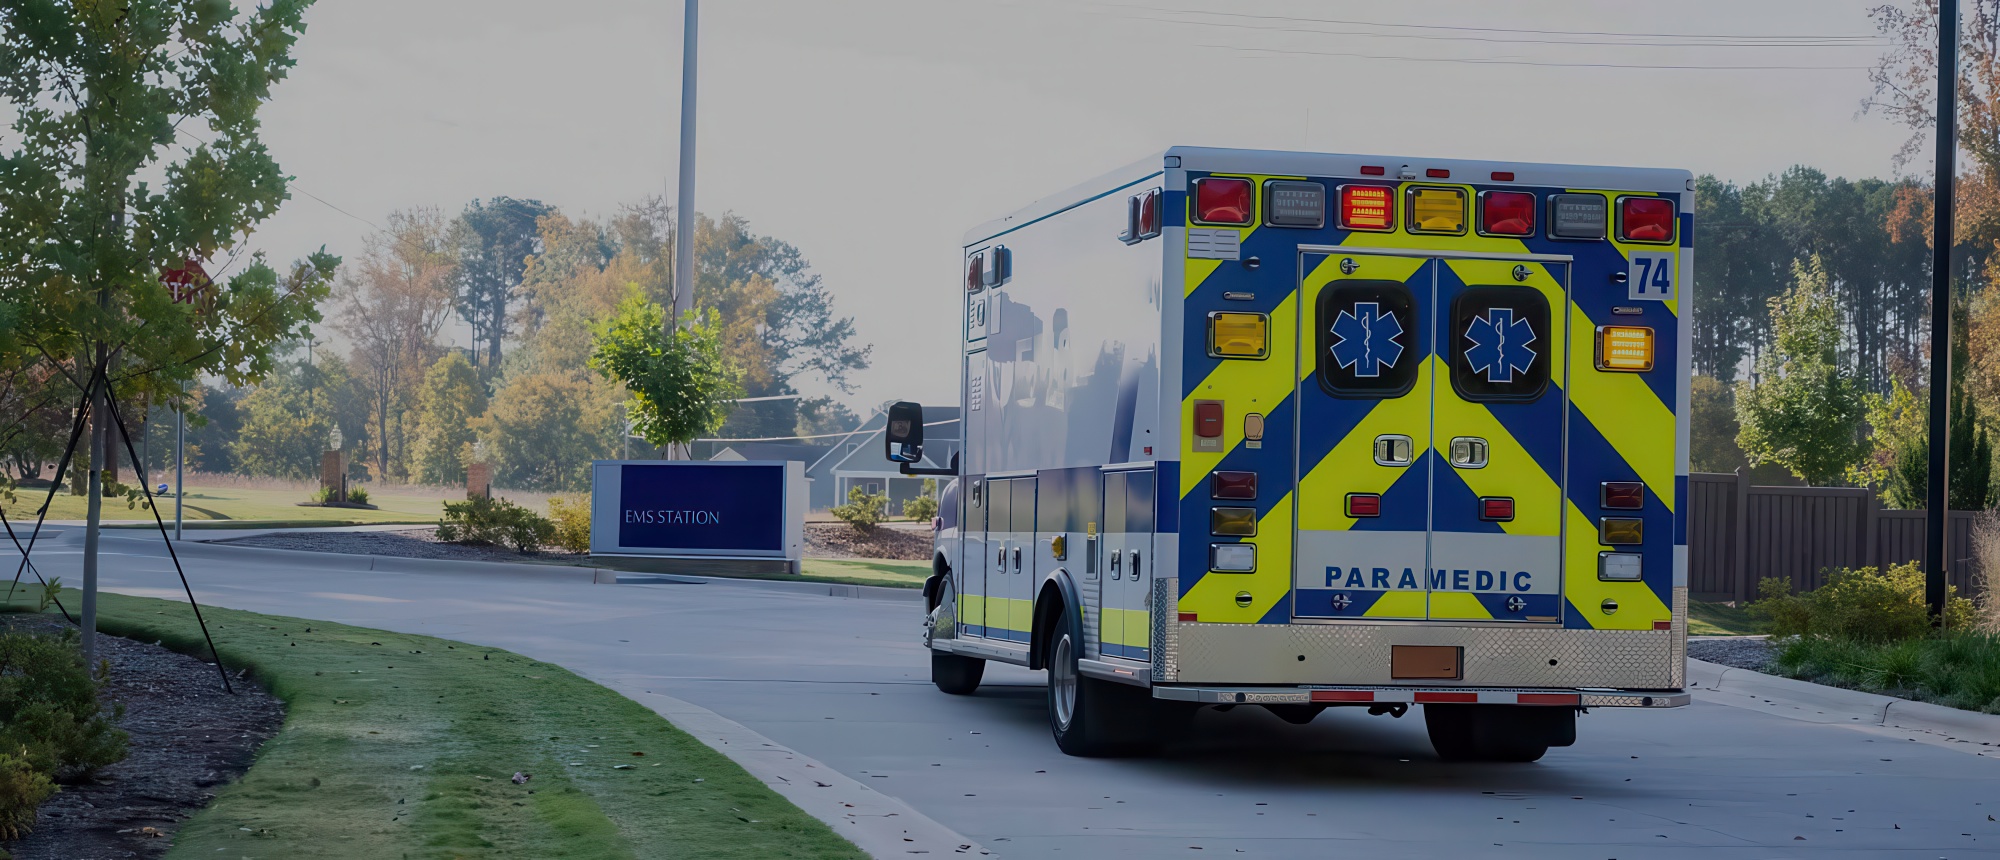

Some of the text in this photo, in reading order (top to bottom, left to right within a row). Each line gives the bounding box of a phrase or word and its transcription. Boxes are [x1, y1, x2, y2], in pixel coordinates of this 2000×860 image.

[1635, 257, 1670, 294] 74
[625, 509, 720, 525] EMS STATION
[1325, 566, 1532, 592] PARAMEDIC
